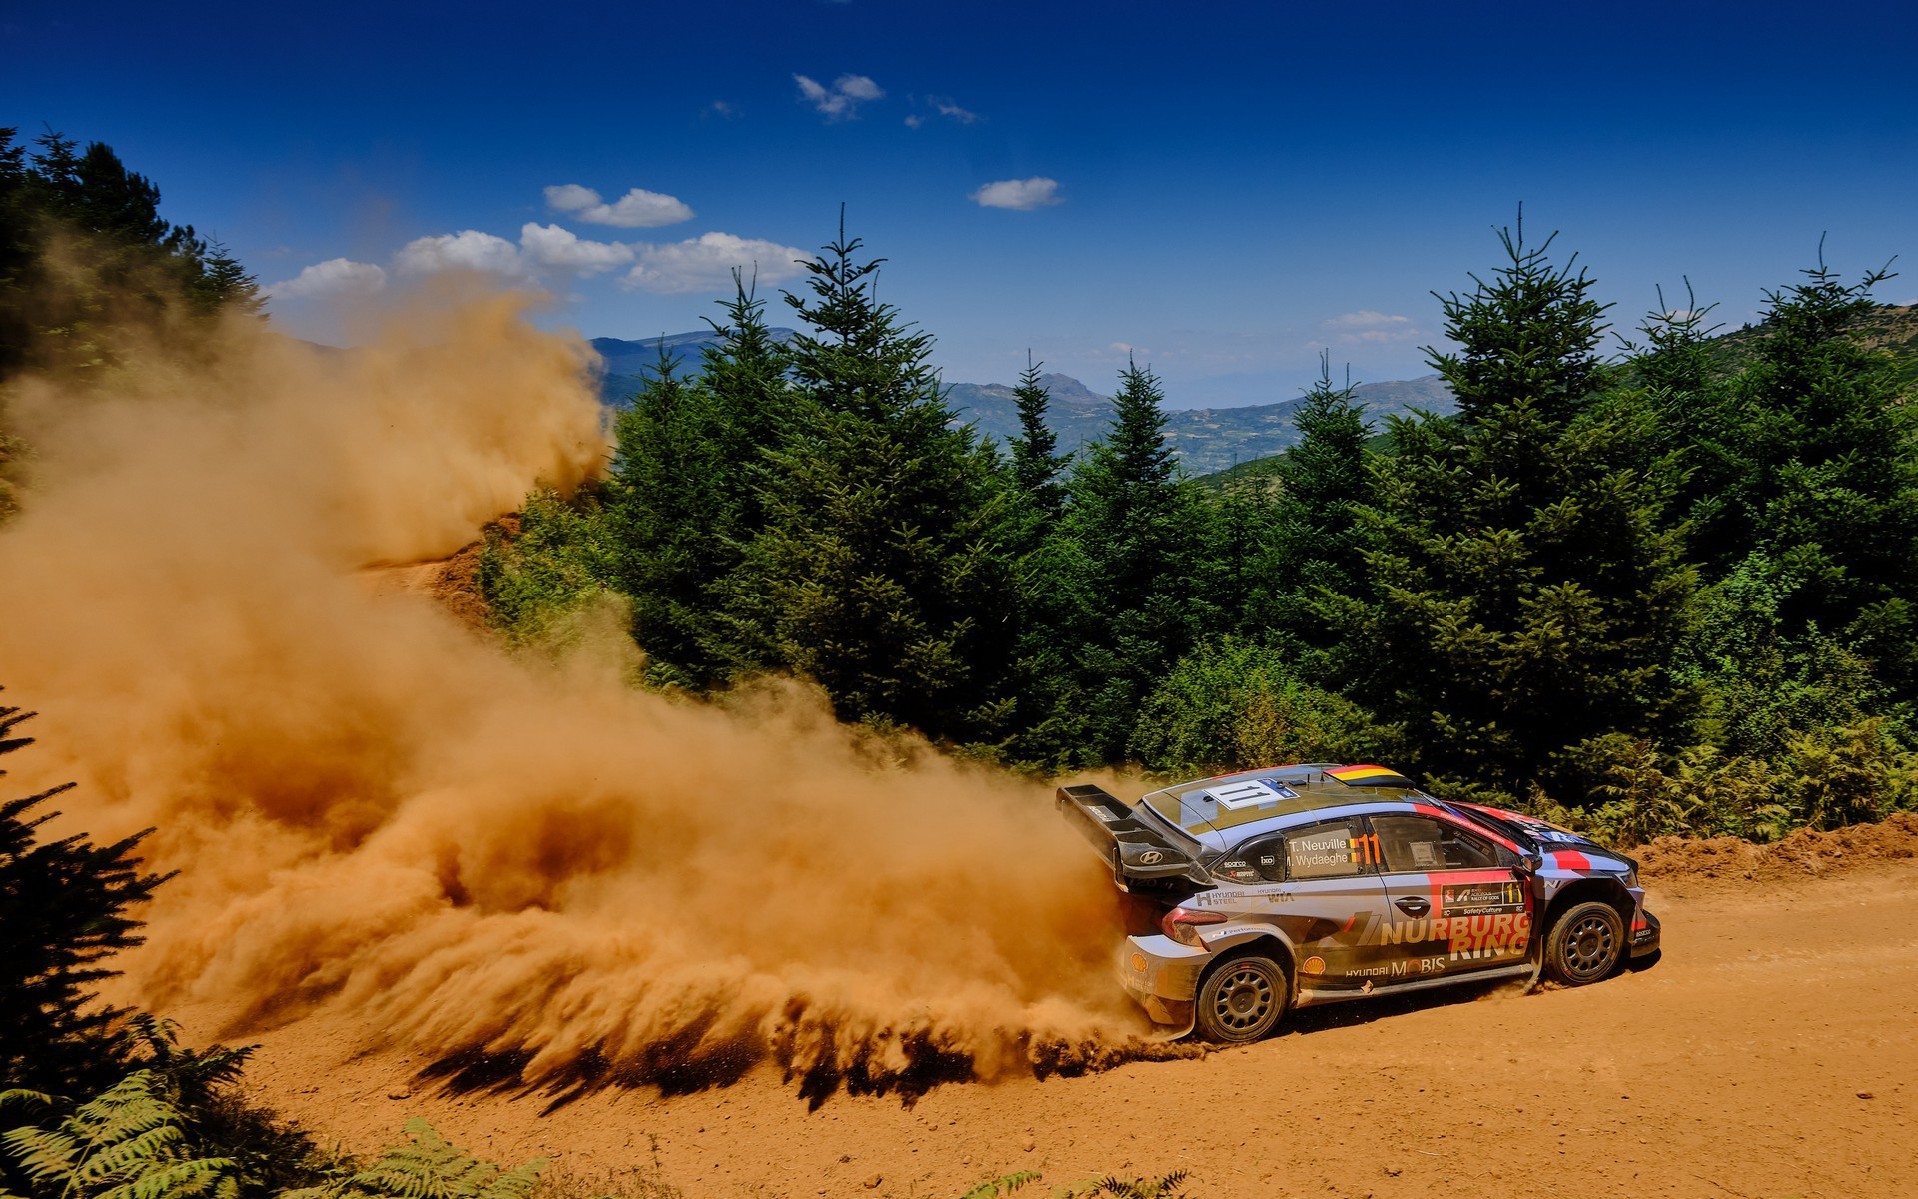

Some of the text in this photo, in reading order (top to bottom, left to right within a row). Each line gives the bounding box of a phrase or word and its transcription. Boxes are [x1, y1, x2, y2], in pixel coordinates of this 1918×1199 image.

[1289, 838, 1347, 852] T. Neuville
[1359, 833, 1380, 865] 11
[1295, 853, 1348, 868] Wydaeghe
[1450, 932, 1529, 961] RING
[1345, 957, 1446, 978] HYUNDAI MOBIS
